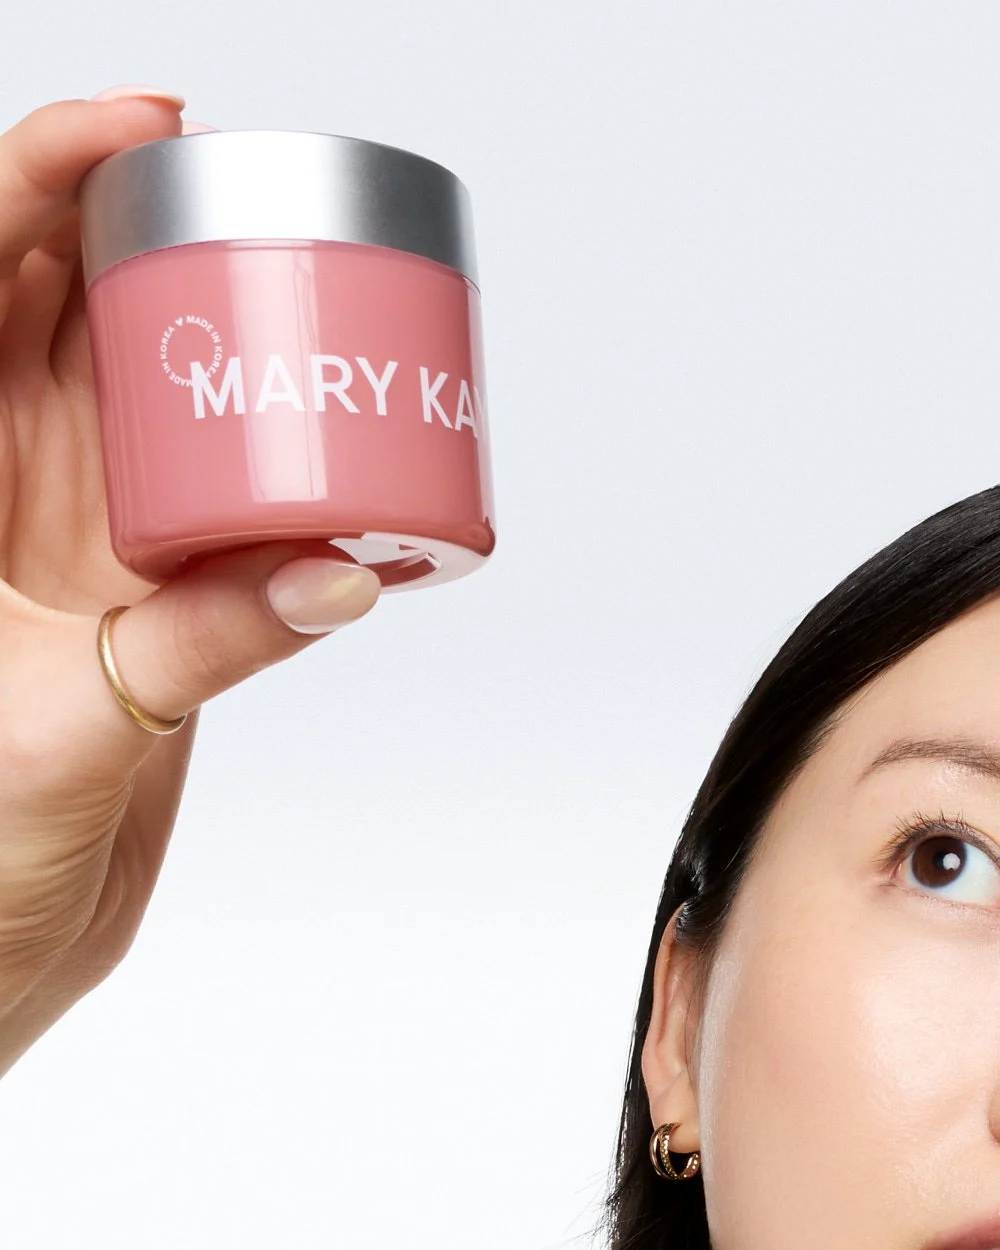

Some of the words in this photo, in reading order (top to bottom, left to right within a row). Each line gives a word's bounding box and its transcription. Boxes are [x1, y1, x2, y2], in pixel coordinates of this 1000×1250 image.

[160, 325, 175, 360] KOREA
[186, 315, 214, 333] MADE
[210, 331, 221, 343] IN
[161, 361, 171, 374] IN
[190, 353, 398, 420] MARY
